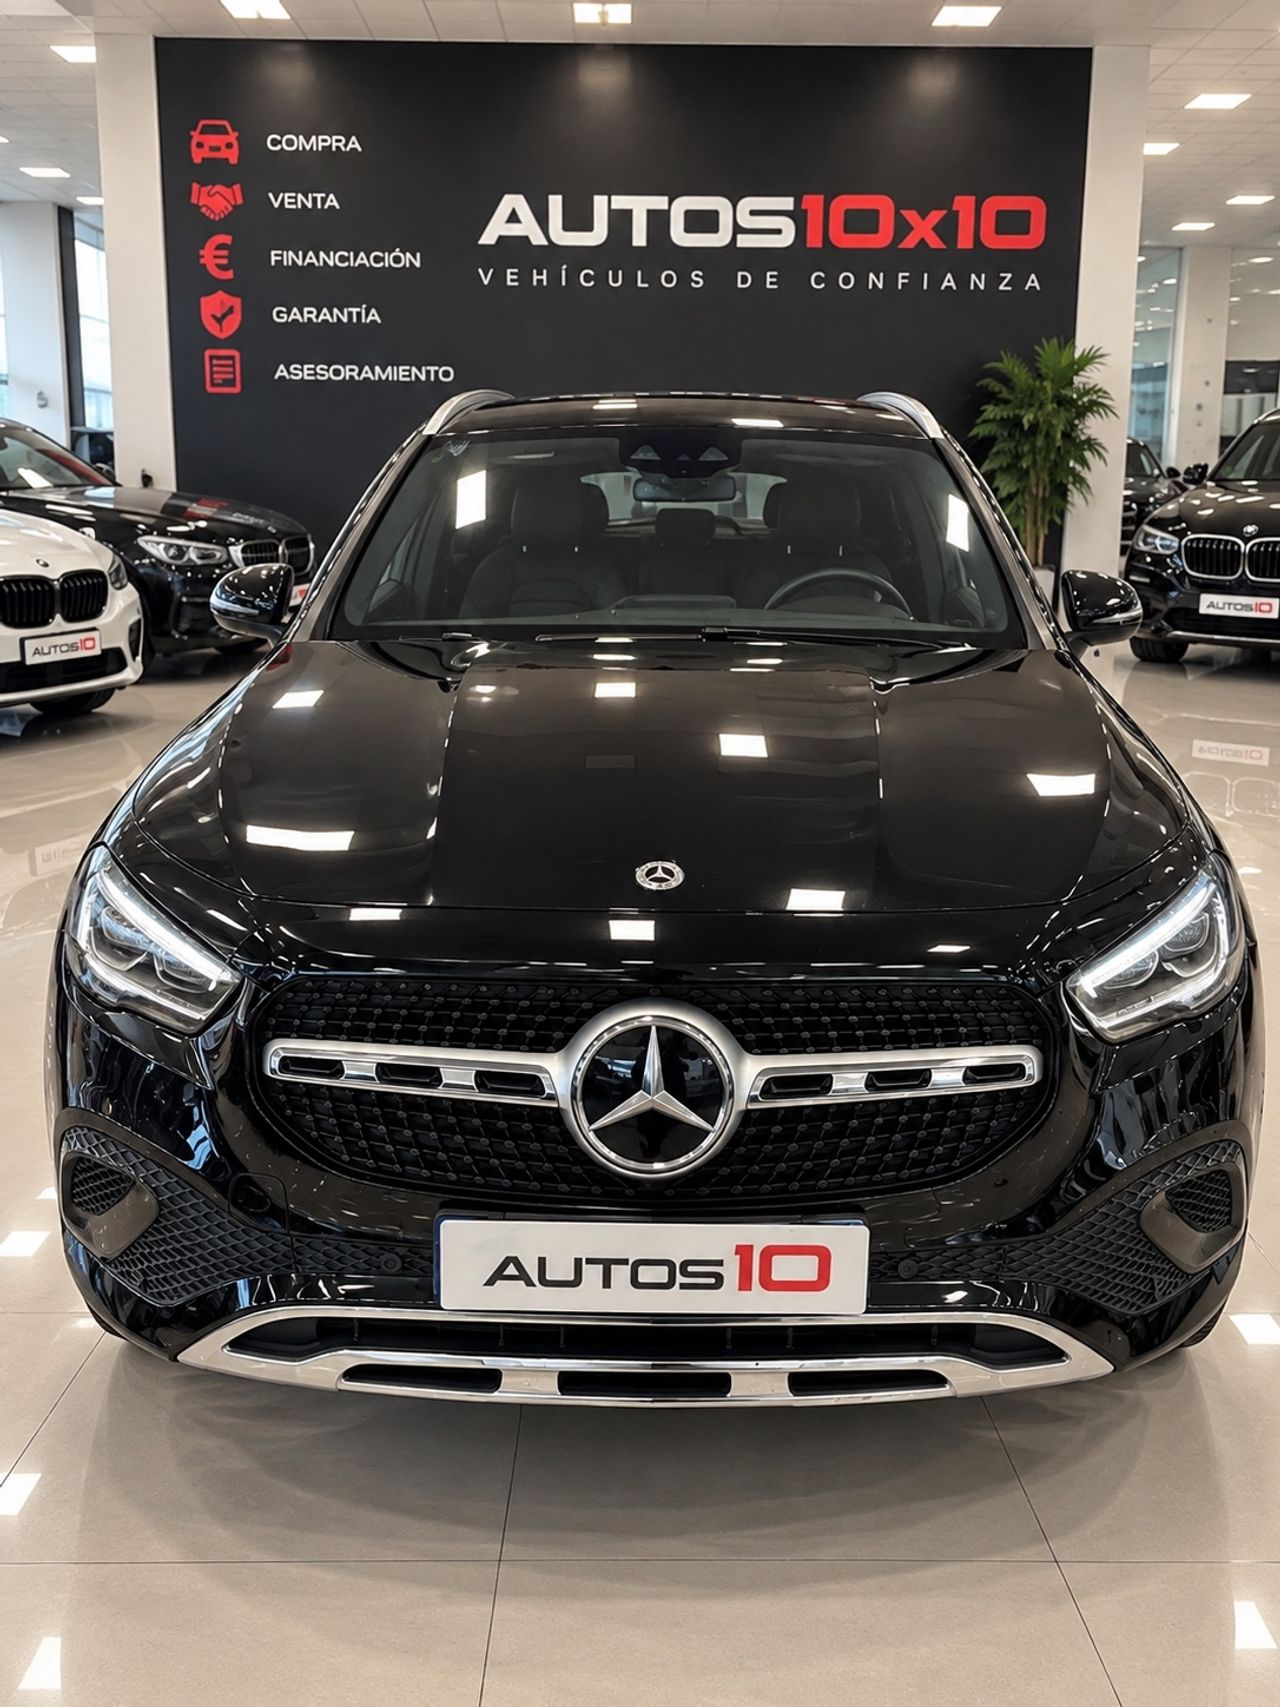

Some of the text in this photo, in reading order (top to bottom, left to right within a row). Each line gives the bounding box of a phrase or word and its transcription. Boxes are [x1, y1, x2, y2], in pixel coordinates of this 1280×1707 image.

[266, 133, 362, 152] COMPRA
[268, 192, 340, 210] VENTA
[477, 193, 1047, 250] AUTOS10x10
[270, 247, 421, 268] FINANCIACIÓN
[478, 265, 1041, 291] VEHÍCULOS DE CONFIANZA
[272, 304, 382, 324] GARANTÍA
[274, 363, 455, 382] ASESORAMIENTO
